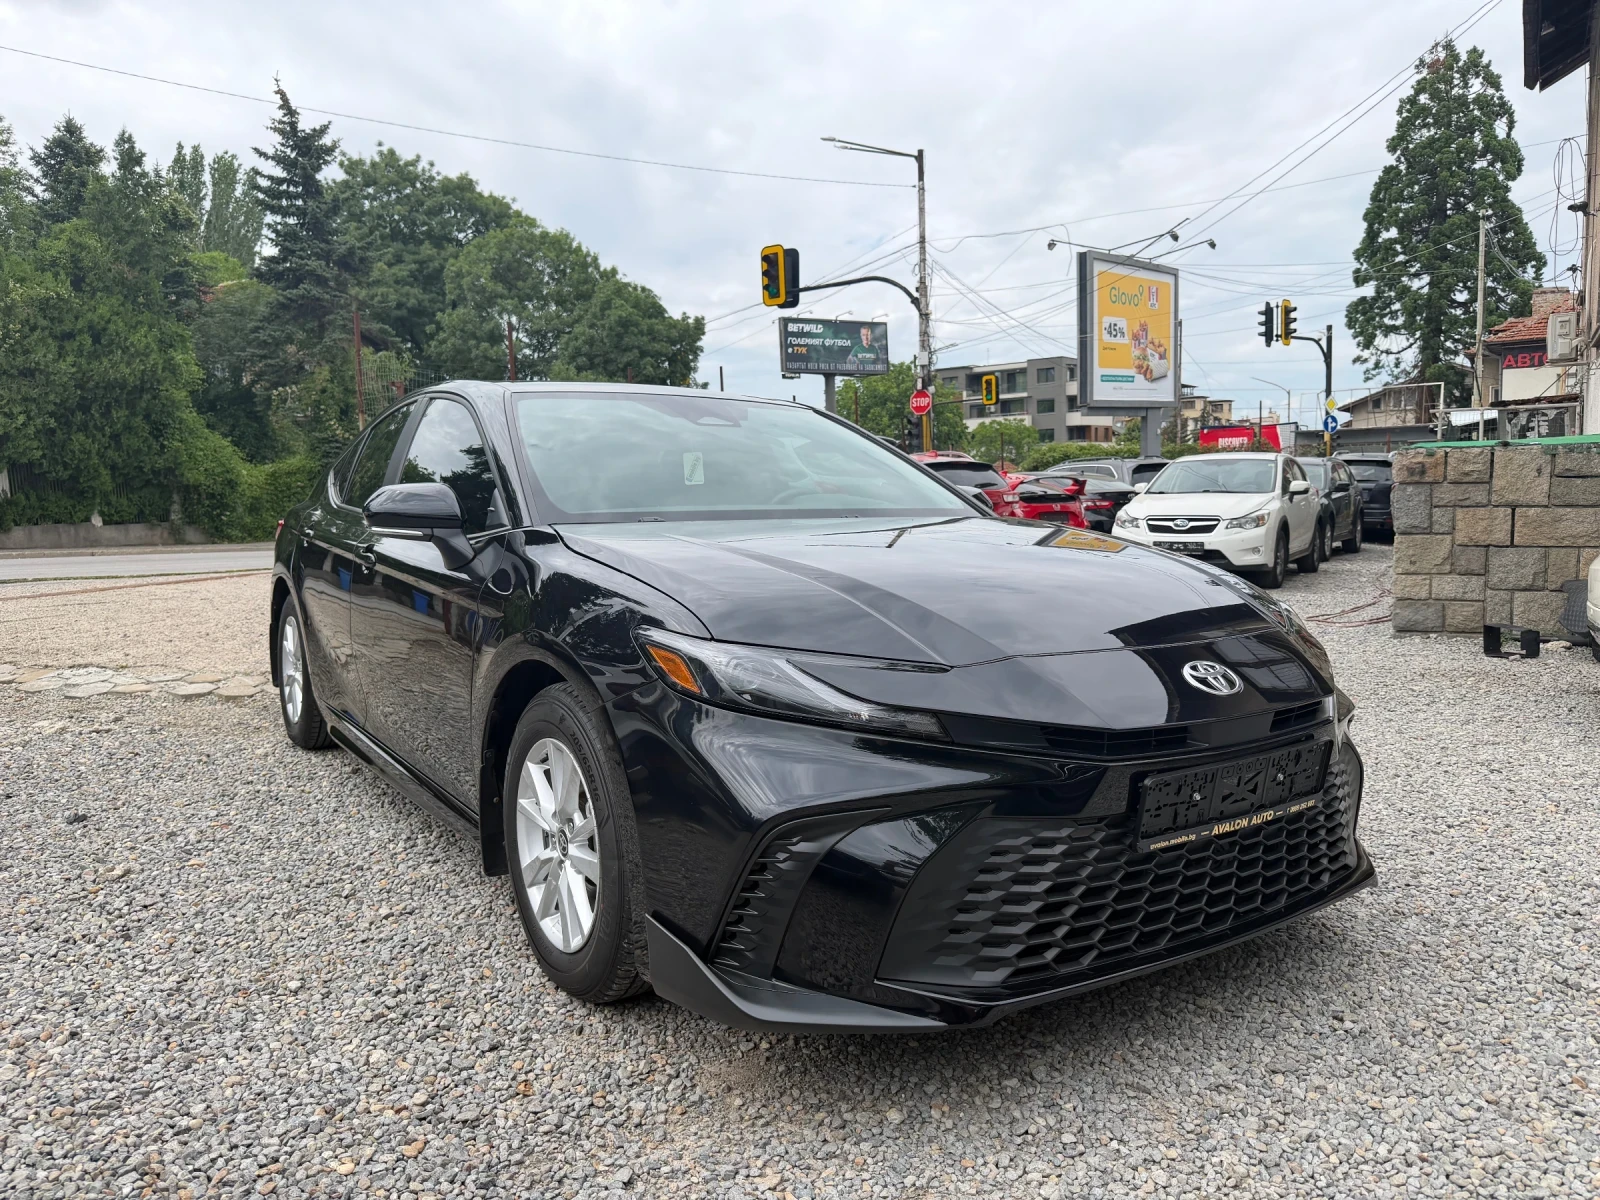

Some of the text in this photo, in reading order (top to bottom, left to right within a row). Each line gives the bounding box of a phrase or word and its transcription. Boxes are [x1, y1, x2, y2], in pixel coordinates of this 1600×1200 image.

[1109, 286, 1140, 307] Glovo
[787, 337, 851, 347] ГОЛЕМИЯТ ФУТБОЛ
[793, 346, 808, 354] ТУК
[912, 397, 930, 407] STOP
[1211, 817, 1249, 836] AVALON
[1250, 810, 1274, 826] AUTO
